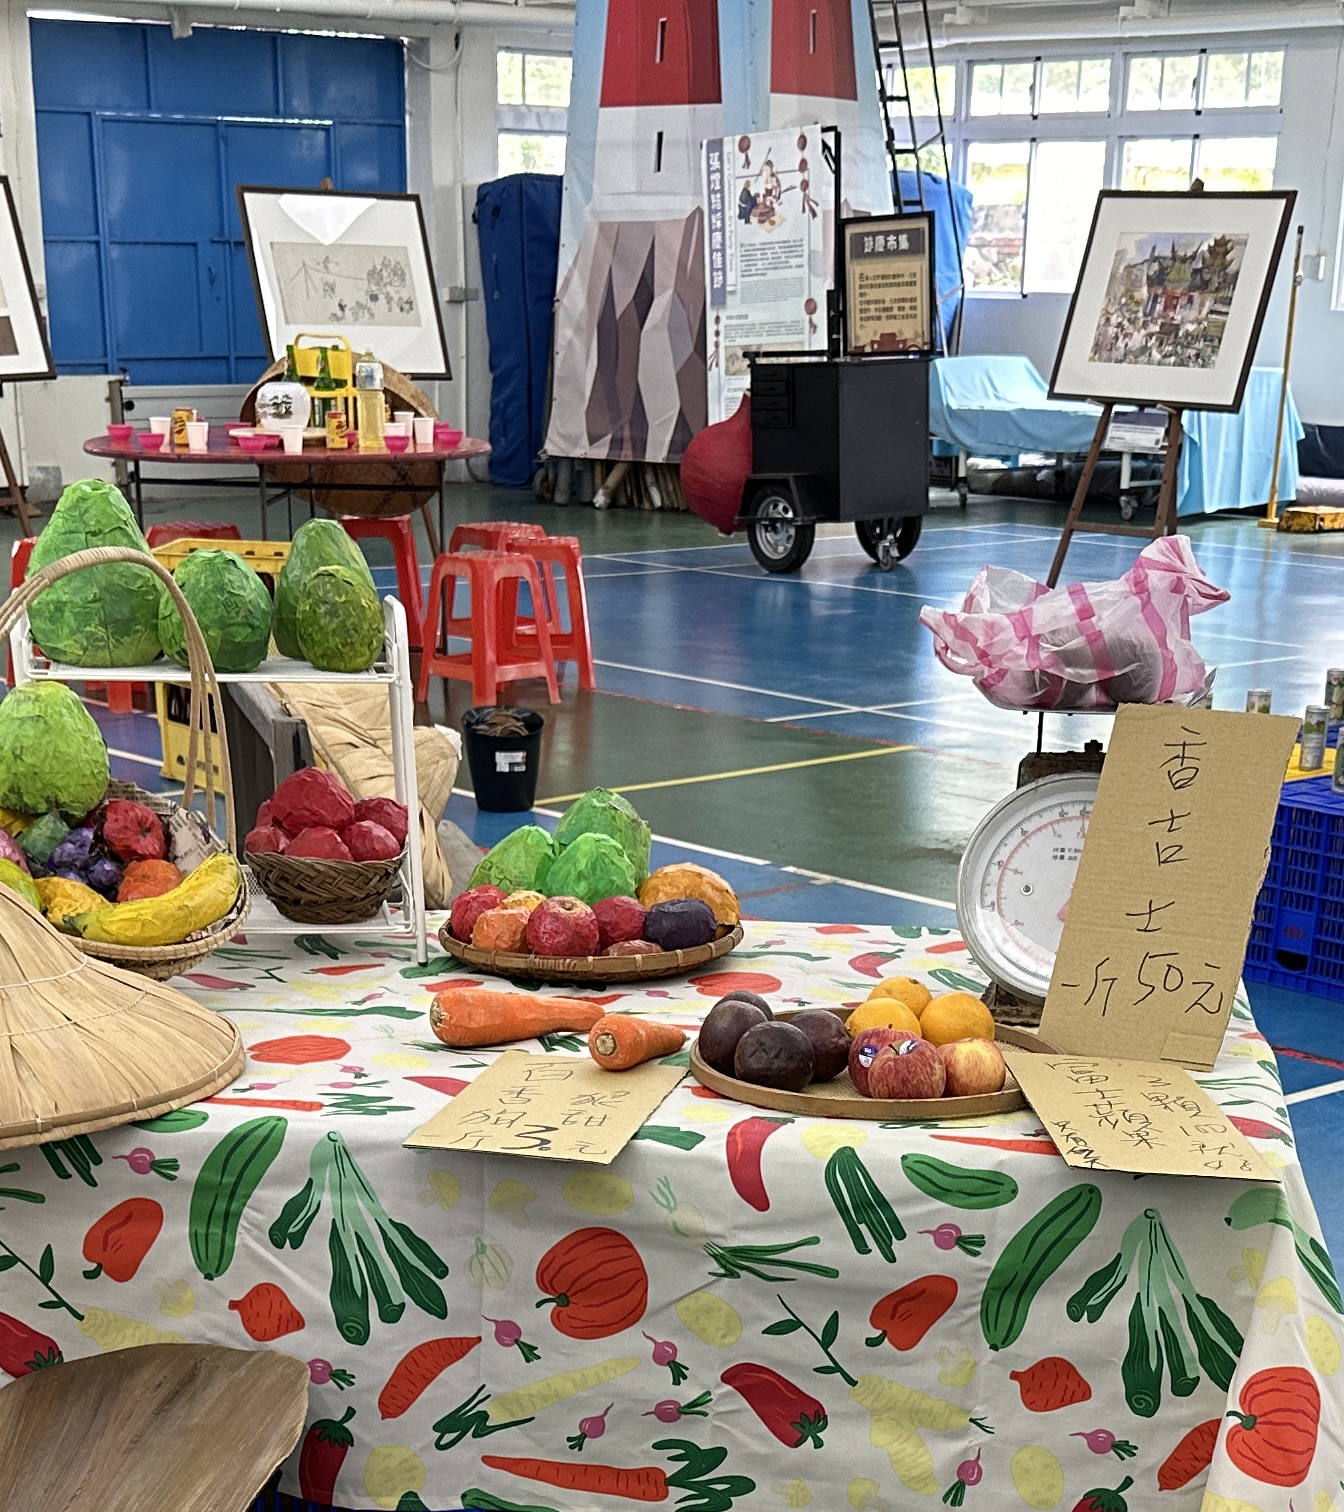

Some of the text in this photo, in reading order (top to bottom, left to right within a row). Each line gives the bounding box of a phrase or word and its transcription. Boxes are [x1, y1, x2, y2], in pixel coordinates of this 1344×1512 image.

[1125, 725, 1208, 933] 香吉士
[1060, 951, 1225, 1017] 一斤50元
